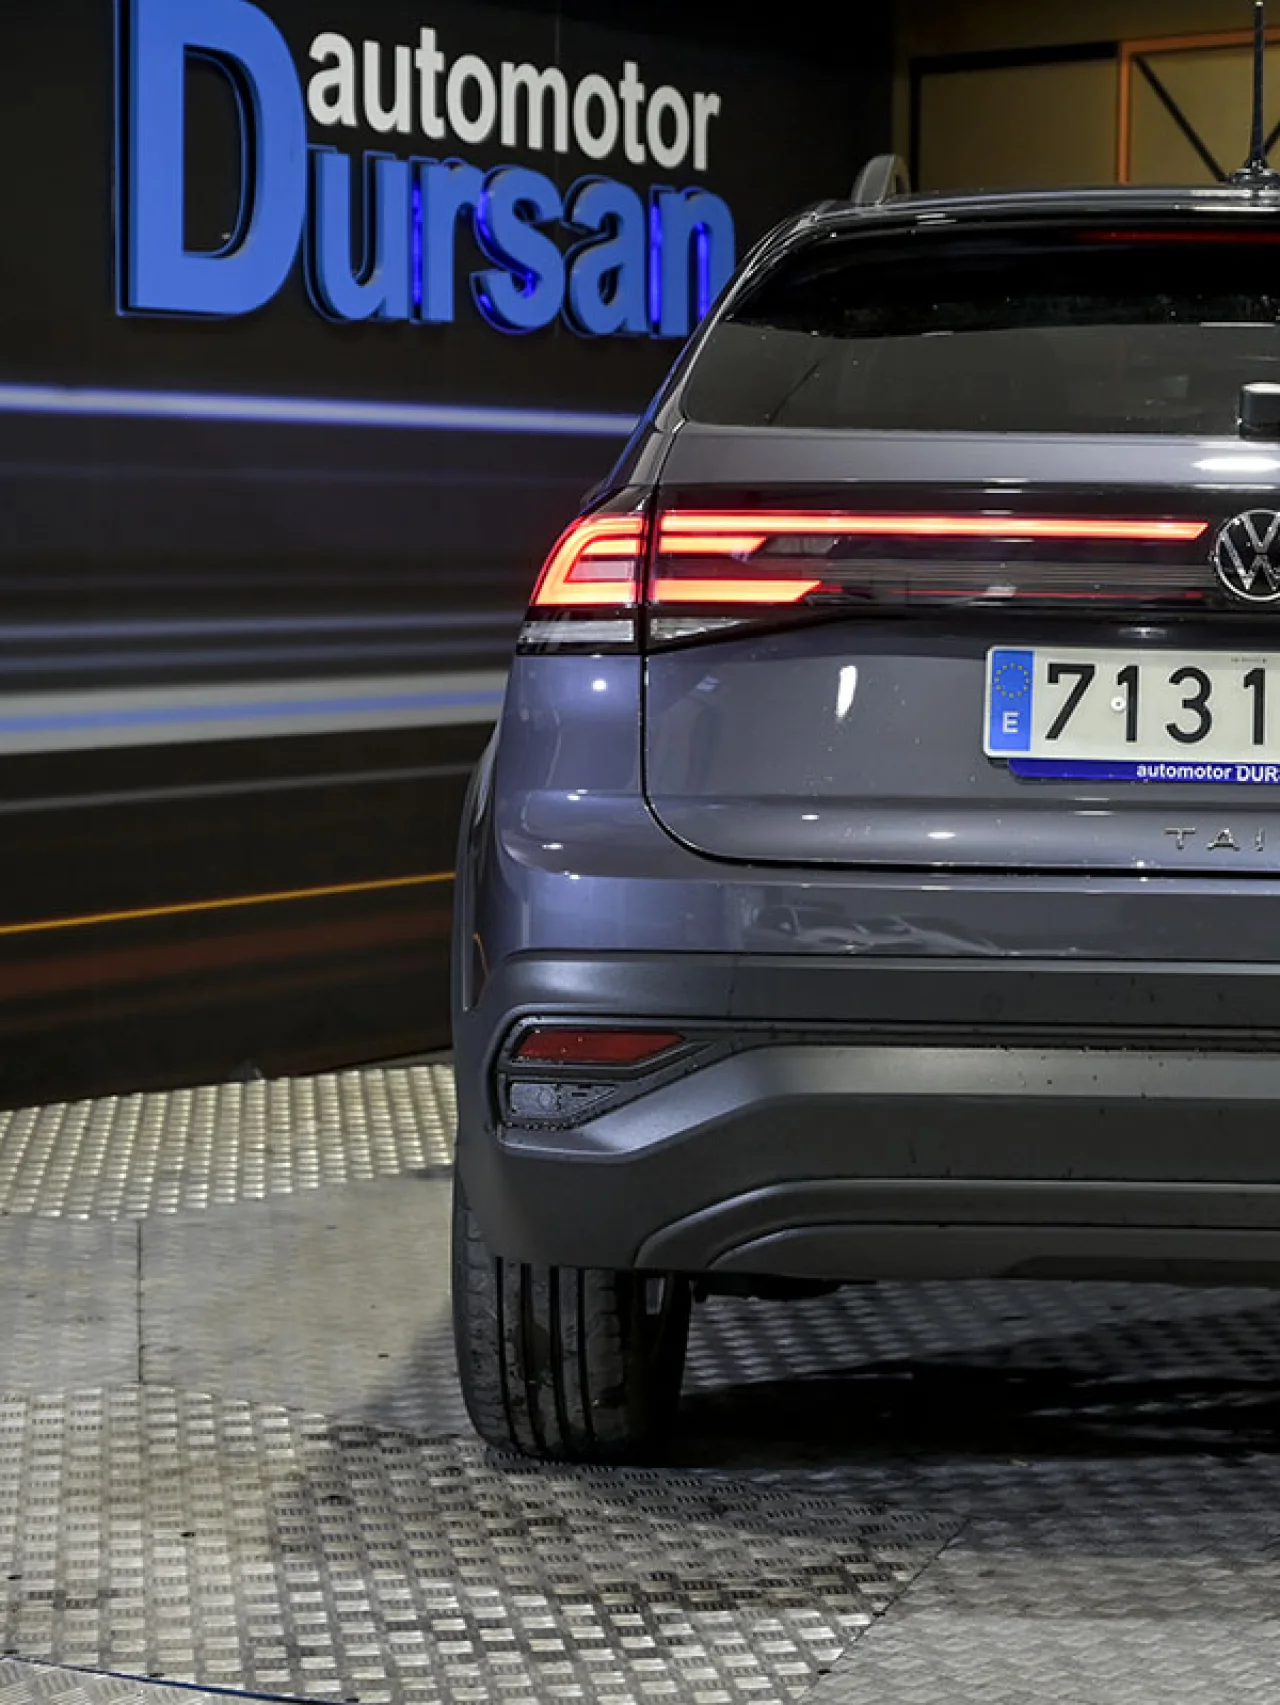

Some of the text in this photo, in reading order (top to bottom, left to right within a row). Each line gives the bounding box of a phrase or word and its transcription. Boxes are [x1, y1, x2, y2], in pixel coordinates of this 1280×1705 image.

[306, 27, 721, 171] automotor
[115, 0, 736, 339] Dursan
[1001, 711, 1020, 734] E
[1044, 662, 1267, 746] 7131
[1136, 764, 1233, 780] automotor
